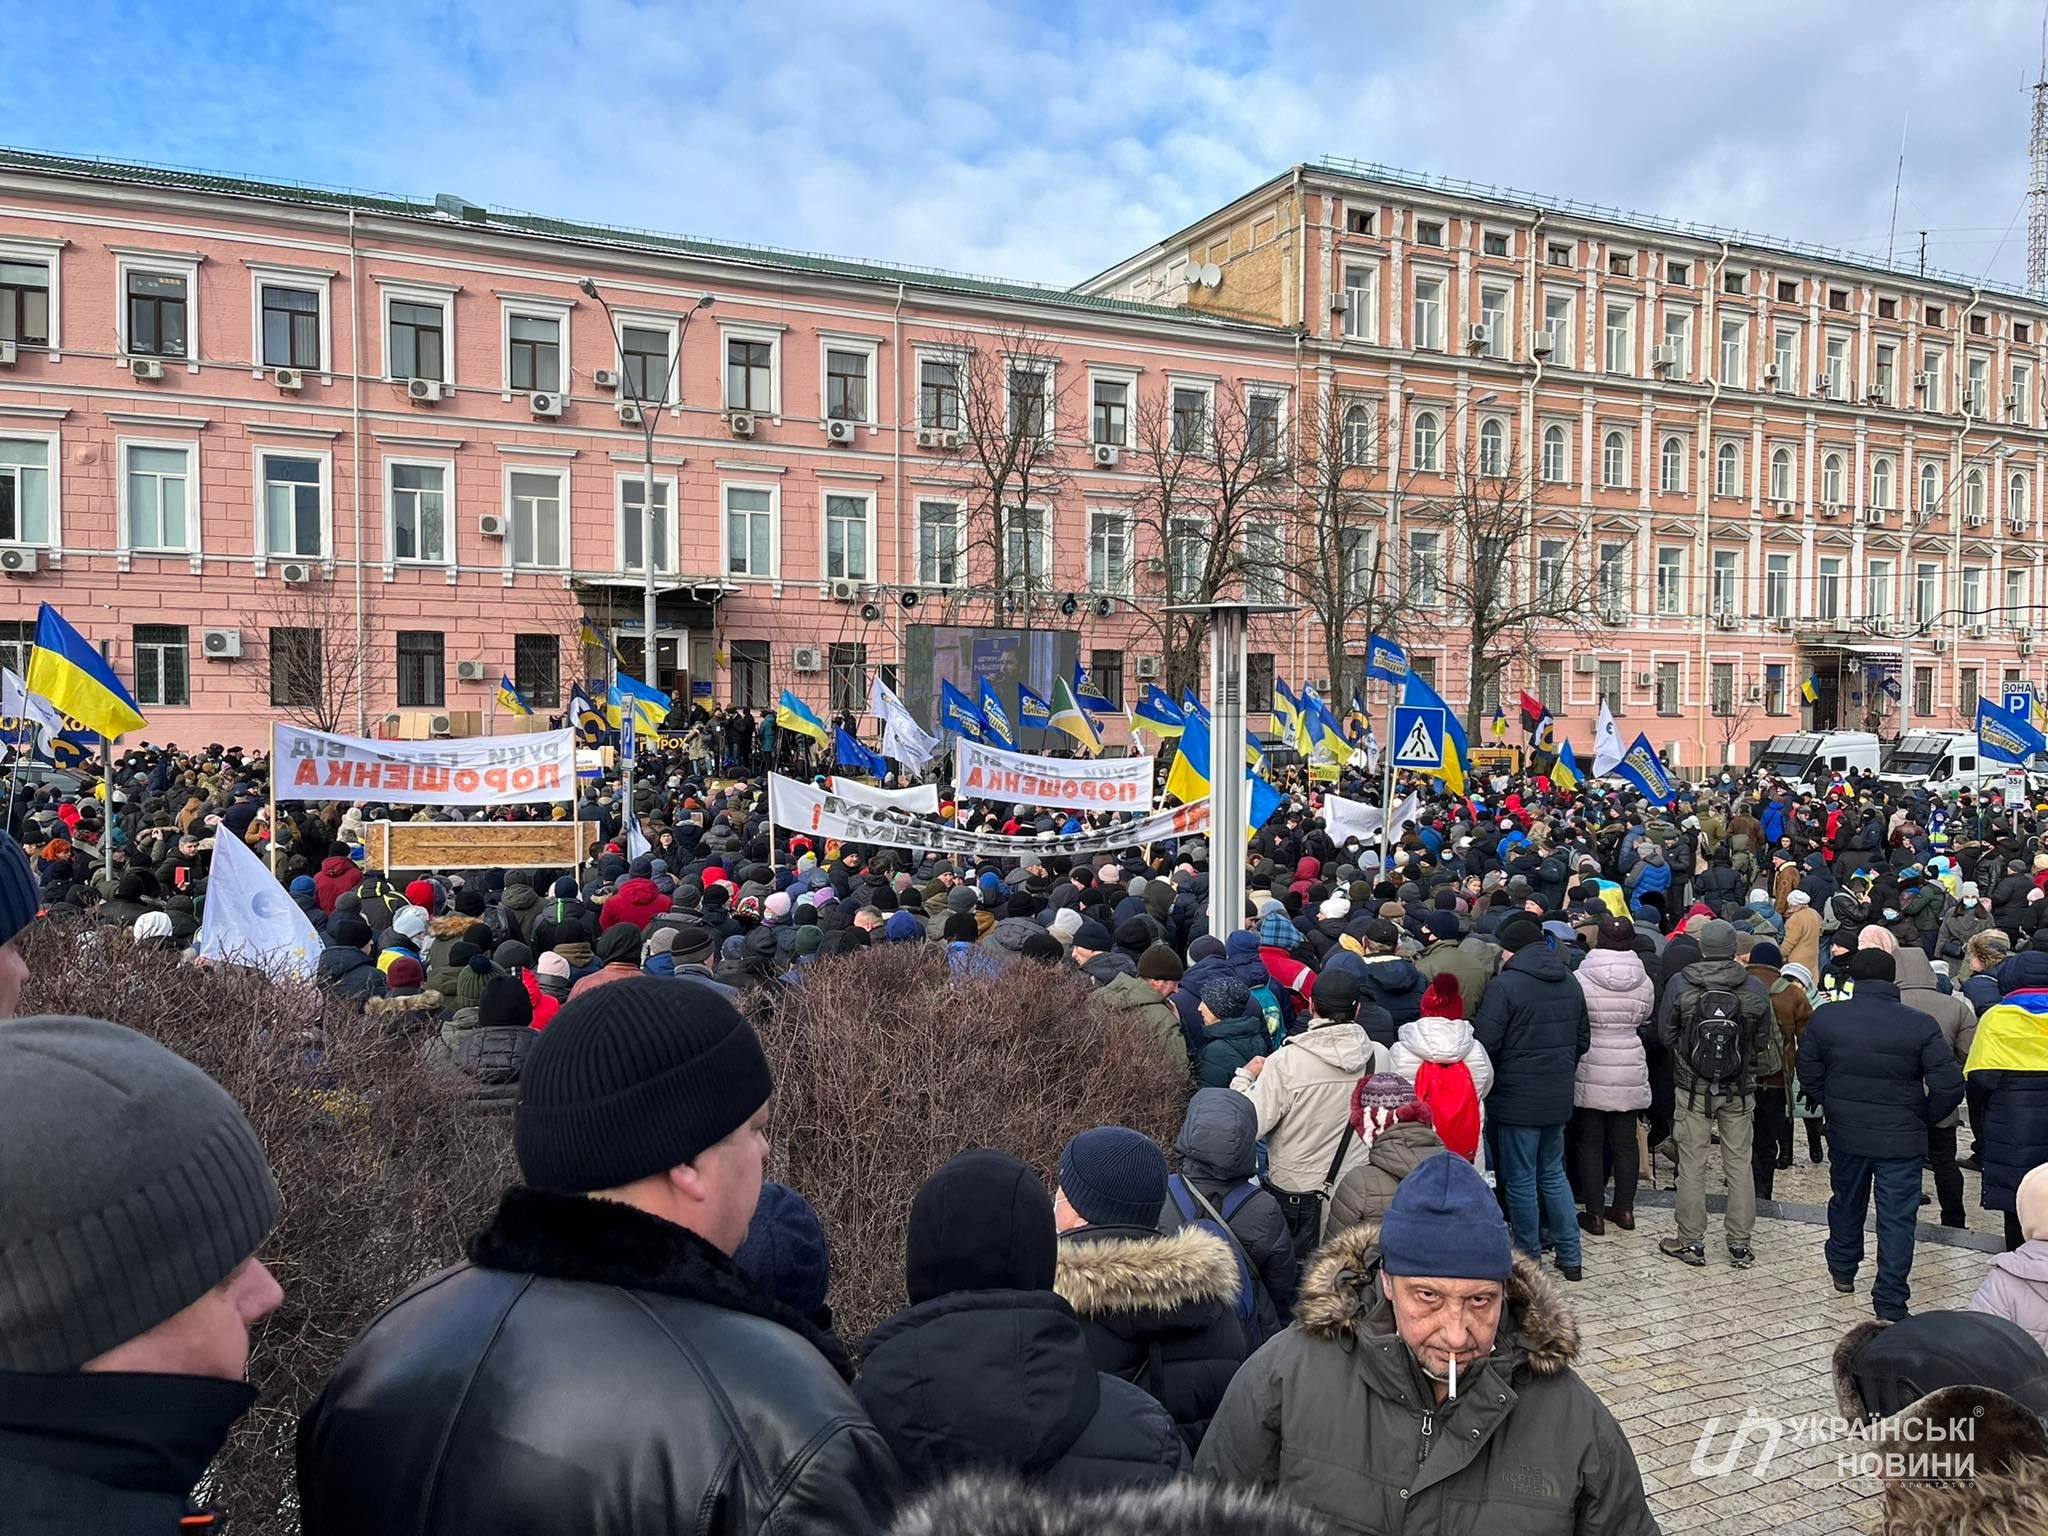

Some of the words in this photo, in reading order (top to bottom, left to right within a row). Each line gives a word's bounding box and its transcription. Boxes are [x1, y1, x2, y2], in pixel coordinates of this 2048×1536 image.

[2004, 683, 2032, 692] ЗОНА
[1502, 1472, 1542, 1486] NORTH
[1511, 1483, 1541, 1496] FACE
